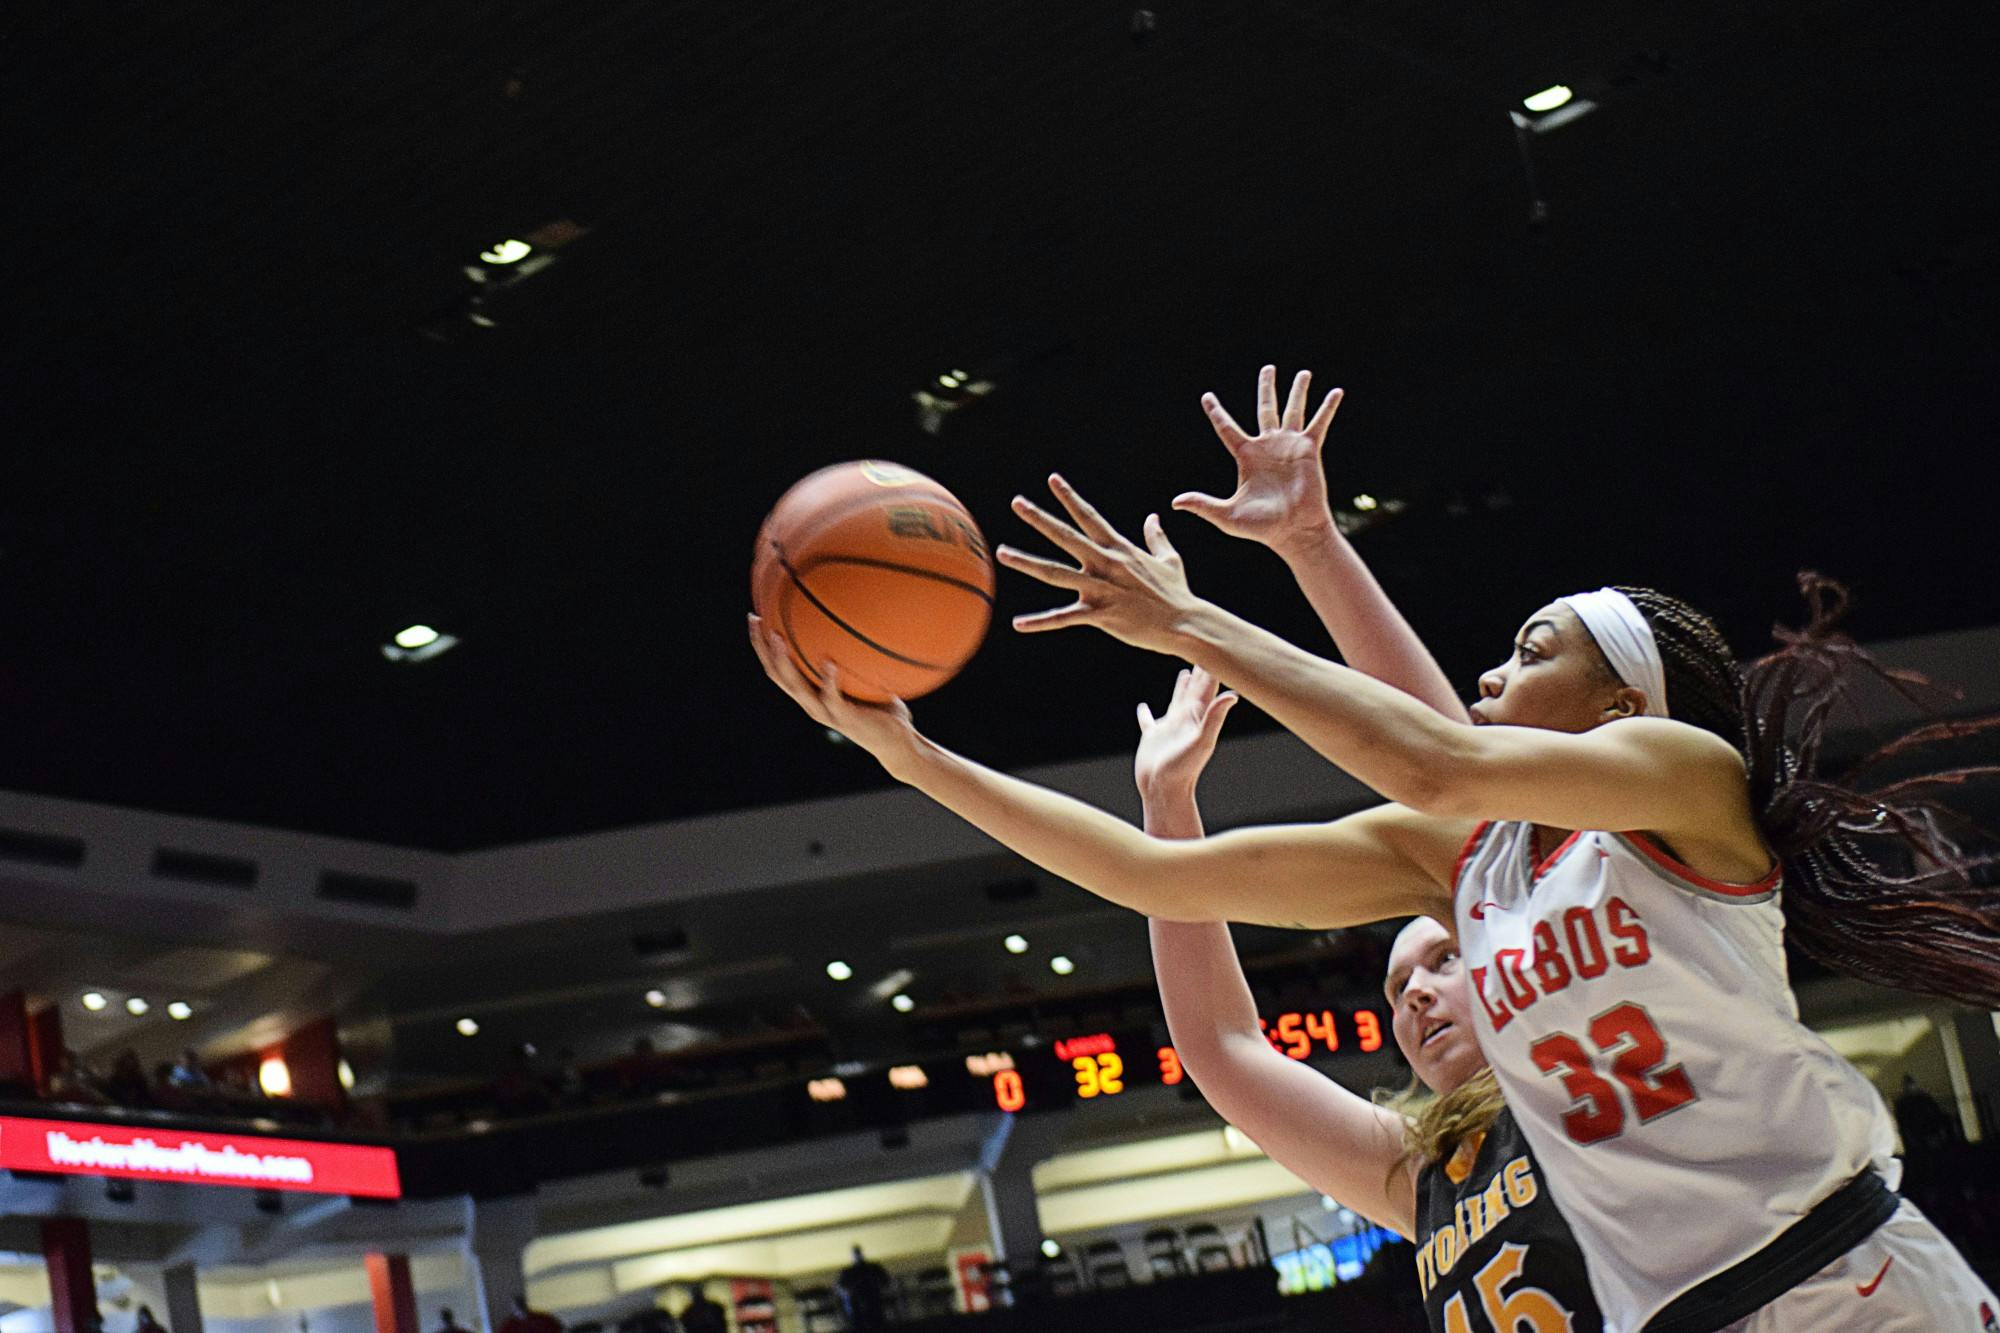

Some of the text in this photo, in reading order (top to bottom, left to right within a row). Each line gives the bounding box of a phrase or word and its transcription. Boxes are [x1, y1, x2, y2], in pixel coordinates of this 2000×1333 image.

[1470, 896, 1652, 1032] LOBOS
[1259, 1010, 1339, 1061] :54
[1354, 1010, 1383, 1052] 3
[994, 1069, 1025, 1113] 0
[1072, 1052, 1124, 1098] 32
[1529, 1000, 1701, 1147] 32
[1416, 1155, 1538, 1302] YOING
